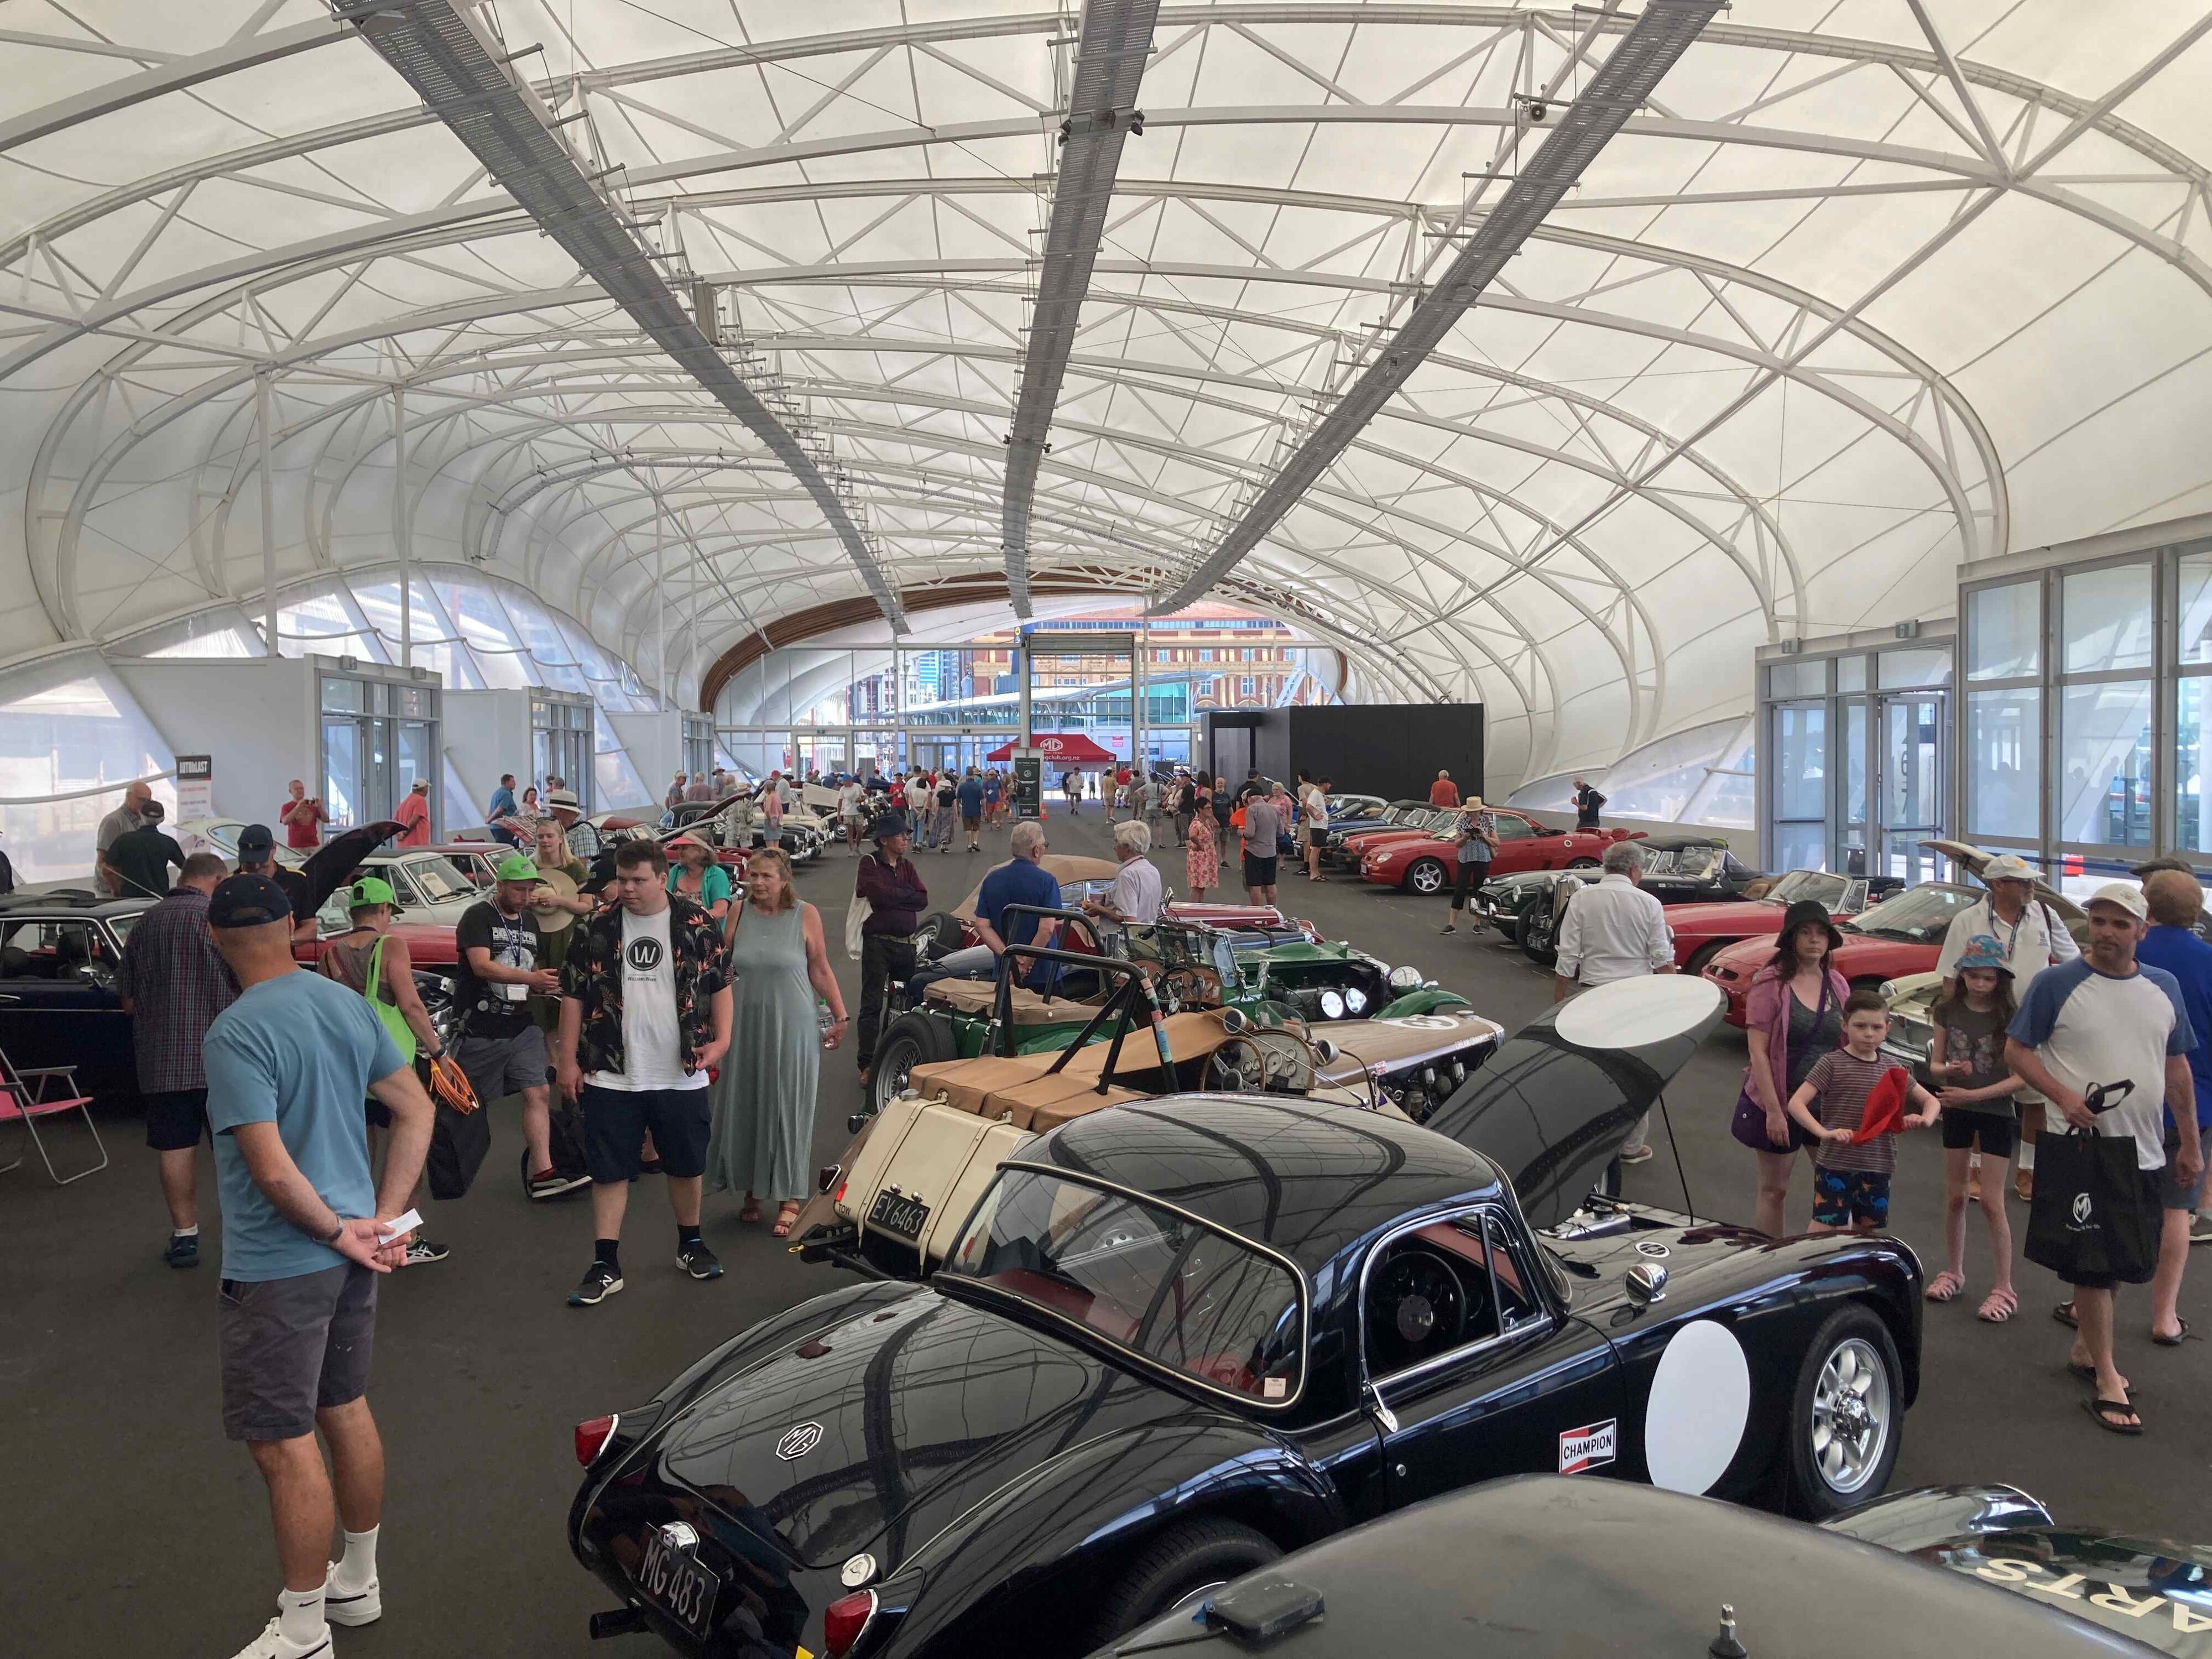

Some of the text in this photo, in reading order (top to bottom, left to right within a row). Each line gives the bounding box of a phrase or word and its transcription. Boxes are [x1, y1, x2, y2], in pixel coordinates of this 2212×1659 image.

[1042, 739, 1061, 750] MG
[634, 946, 656, 963] W
[838, 1203, 851, 1216] TOW
[781, 1426, 818, 1456] MG
[1563, 1434, 1612, 1460] CHAMPION
